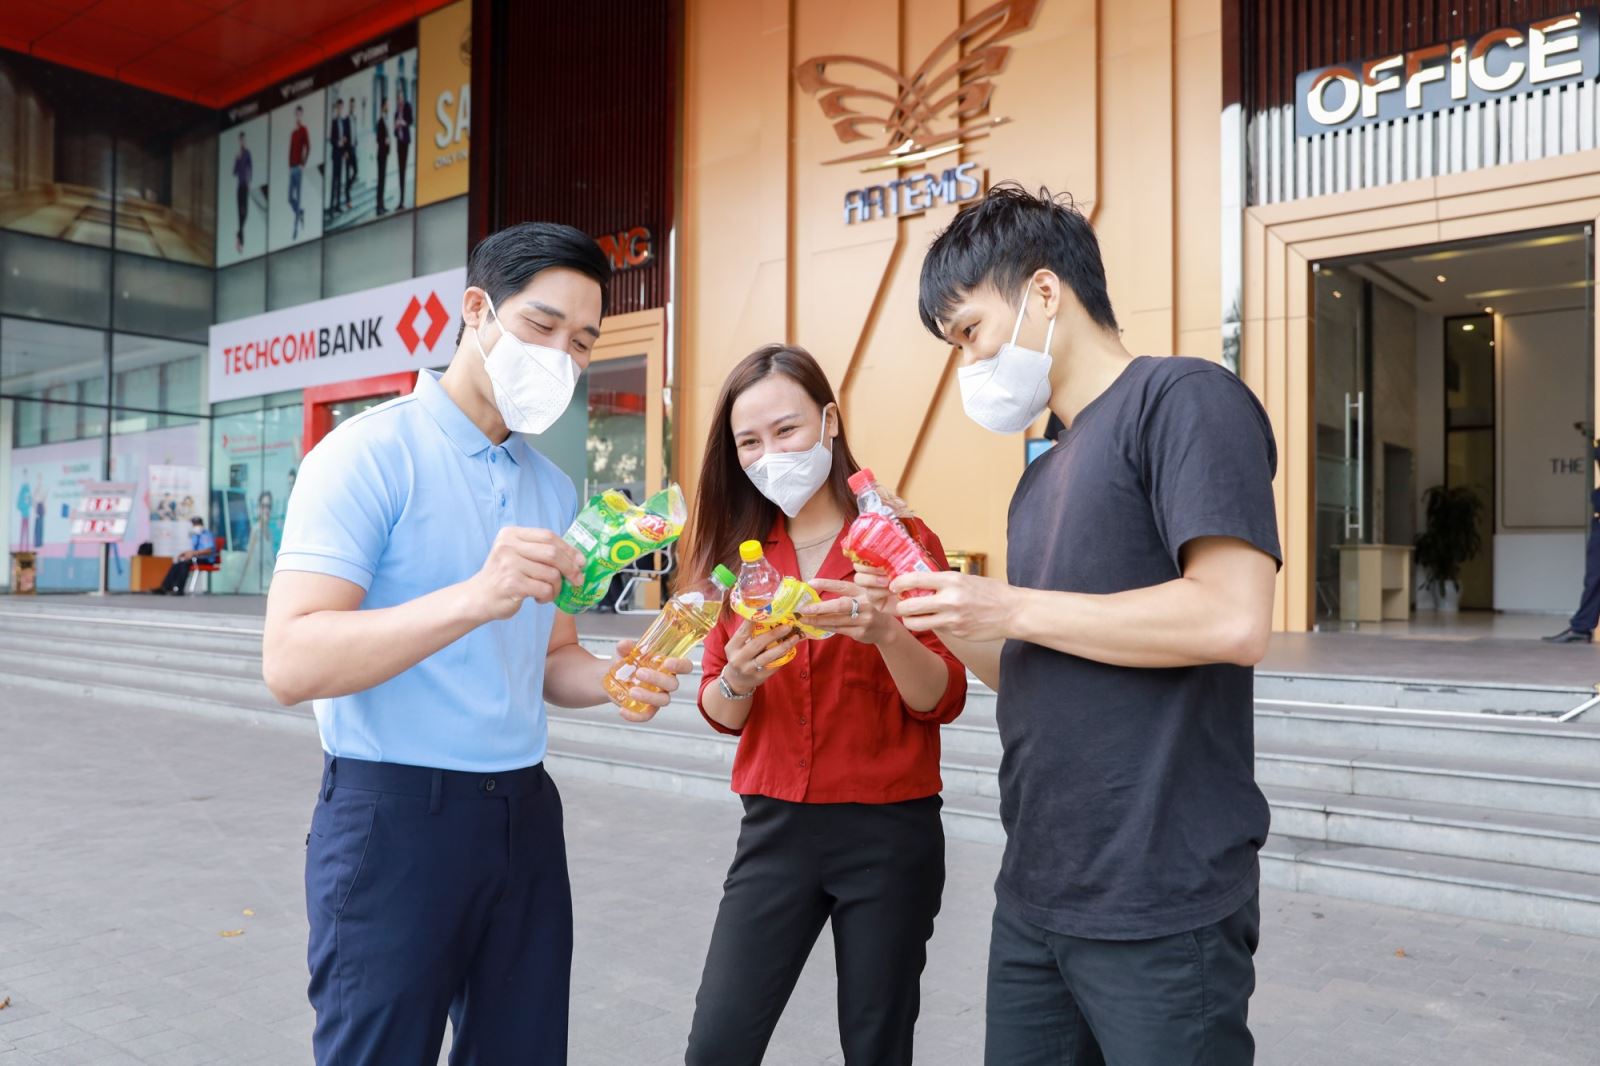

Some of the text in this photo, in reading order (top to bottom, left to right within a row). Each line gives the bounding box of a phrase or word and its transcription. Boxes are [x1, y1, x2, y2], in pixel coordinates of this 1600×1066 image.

[1307, 11, 1582, 125] OFFICE
[844, 161, 979, 225] ARTEMIS
[223, 316, 383, 376] TECHCOMBANK
[1550, 457, 1585, 474] THE
